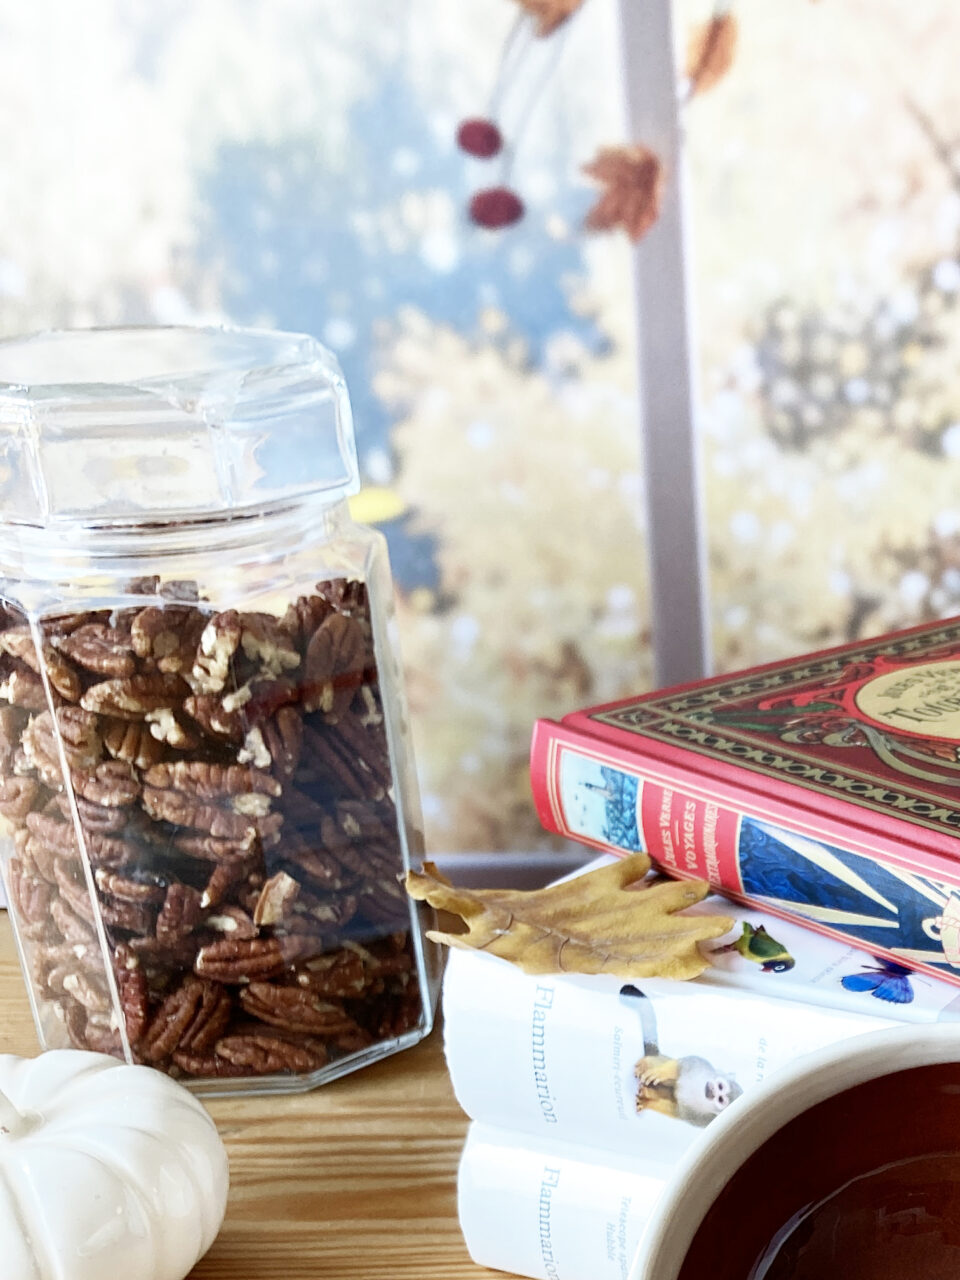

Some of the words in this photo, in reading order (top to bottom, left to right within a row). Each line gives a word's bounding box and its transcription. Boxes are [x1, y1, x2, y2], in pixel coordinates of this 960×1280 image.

[659, 788, 673, 827] VERNE
[661, 829, 677, 869] JULES
[683, 801, 698, 869] VOYAGES
[531, 984, 558, 1124] Flammarion
